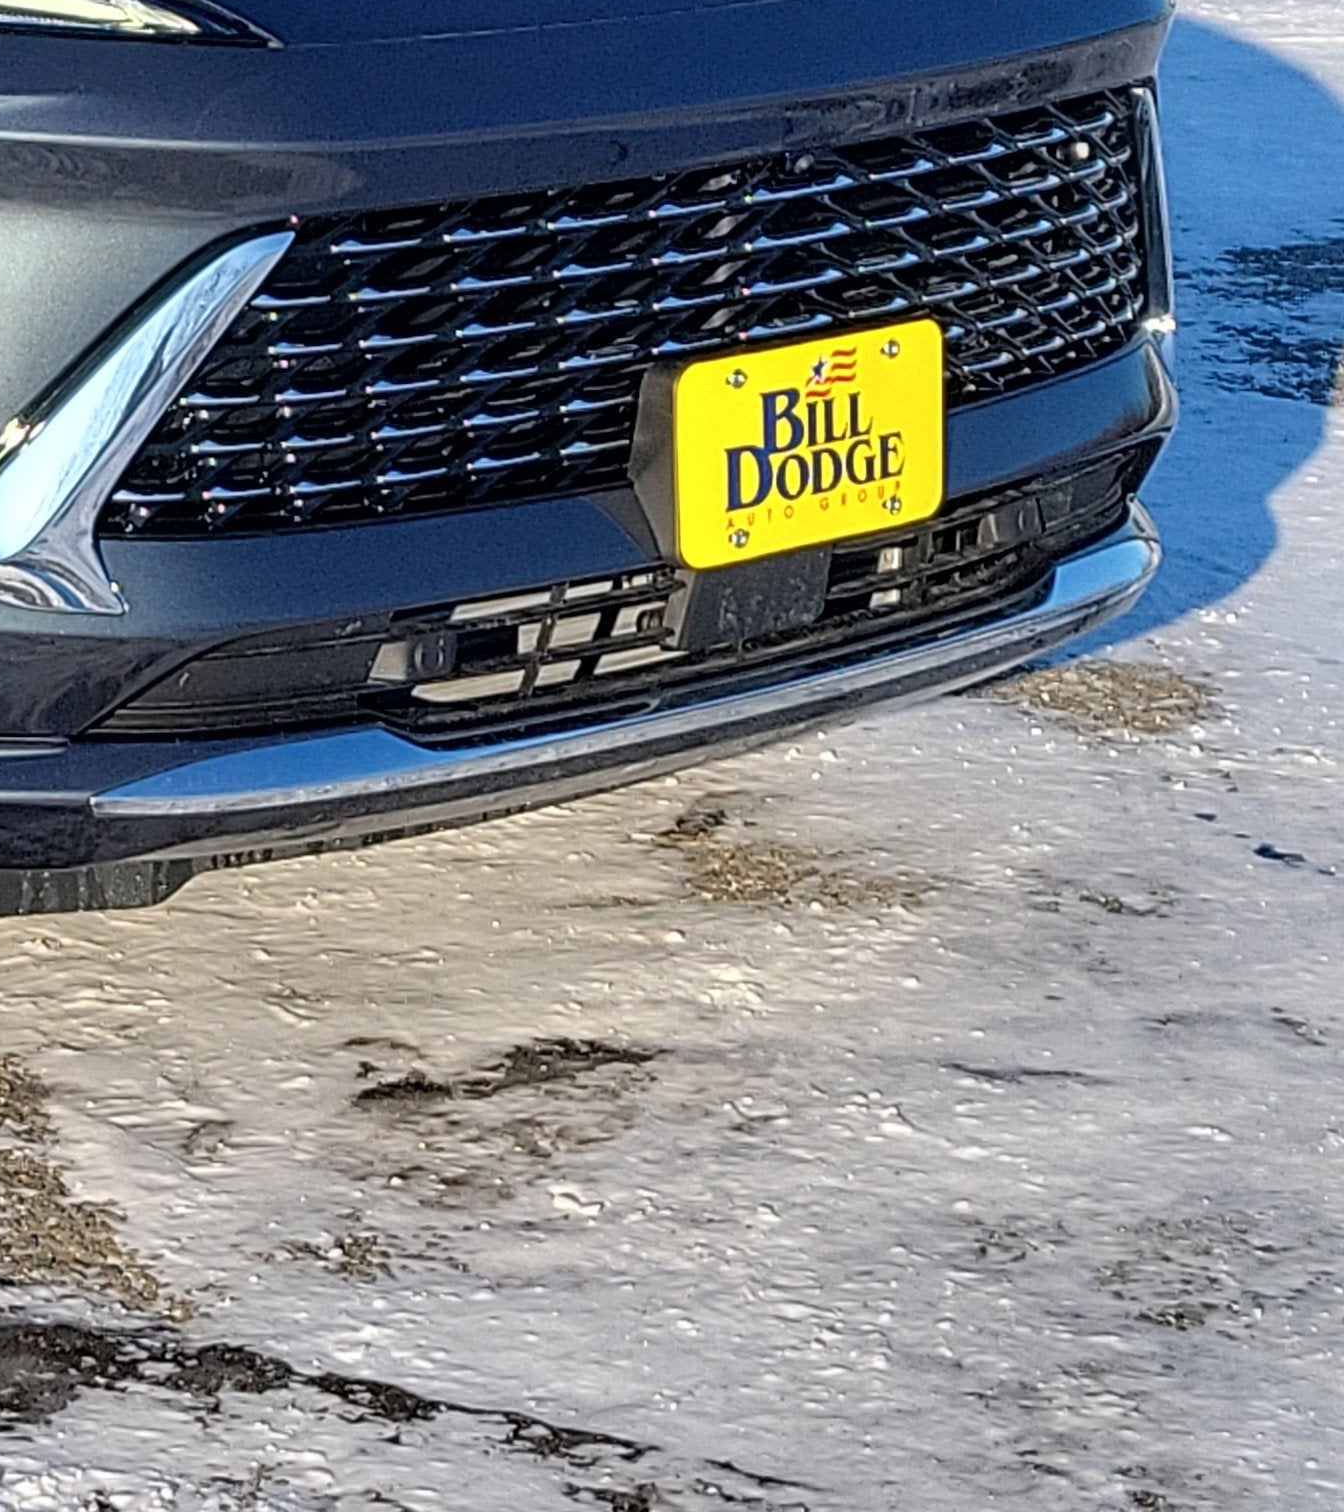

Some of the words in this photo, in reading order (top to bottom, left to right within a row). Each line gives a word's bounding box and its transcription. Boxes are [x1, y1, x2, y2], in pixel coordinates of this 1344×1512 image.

[759, 387, 874, 454] BILL
[723, 431, 906, 513] DODGE
[726, 504, 795, 530] AUTO
[819, 480, 901, 511] GROUP
